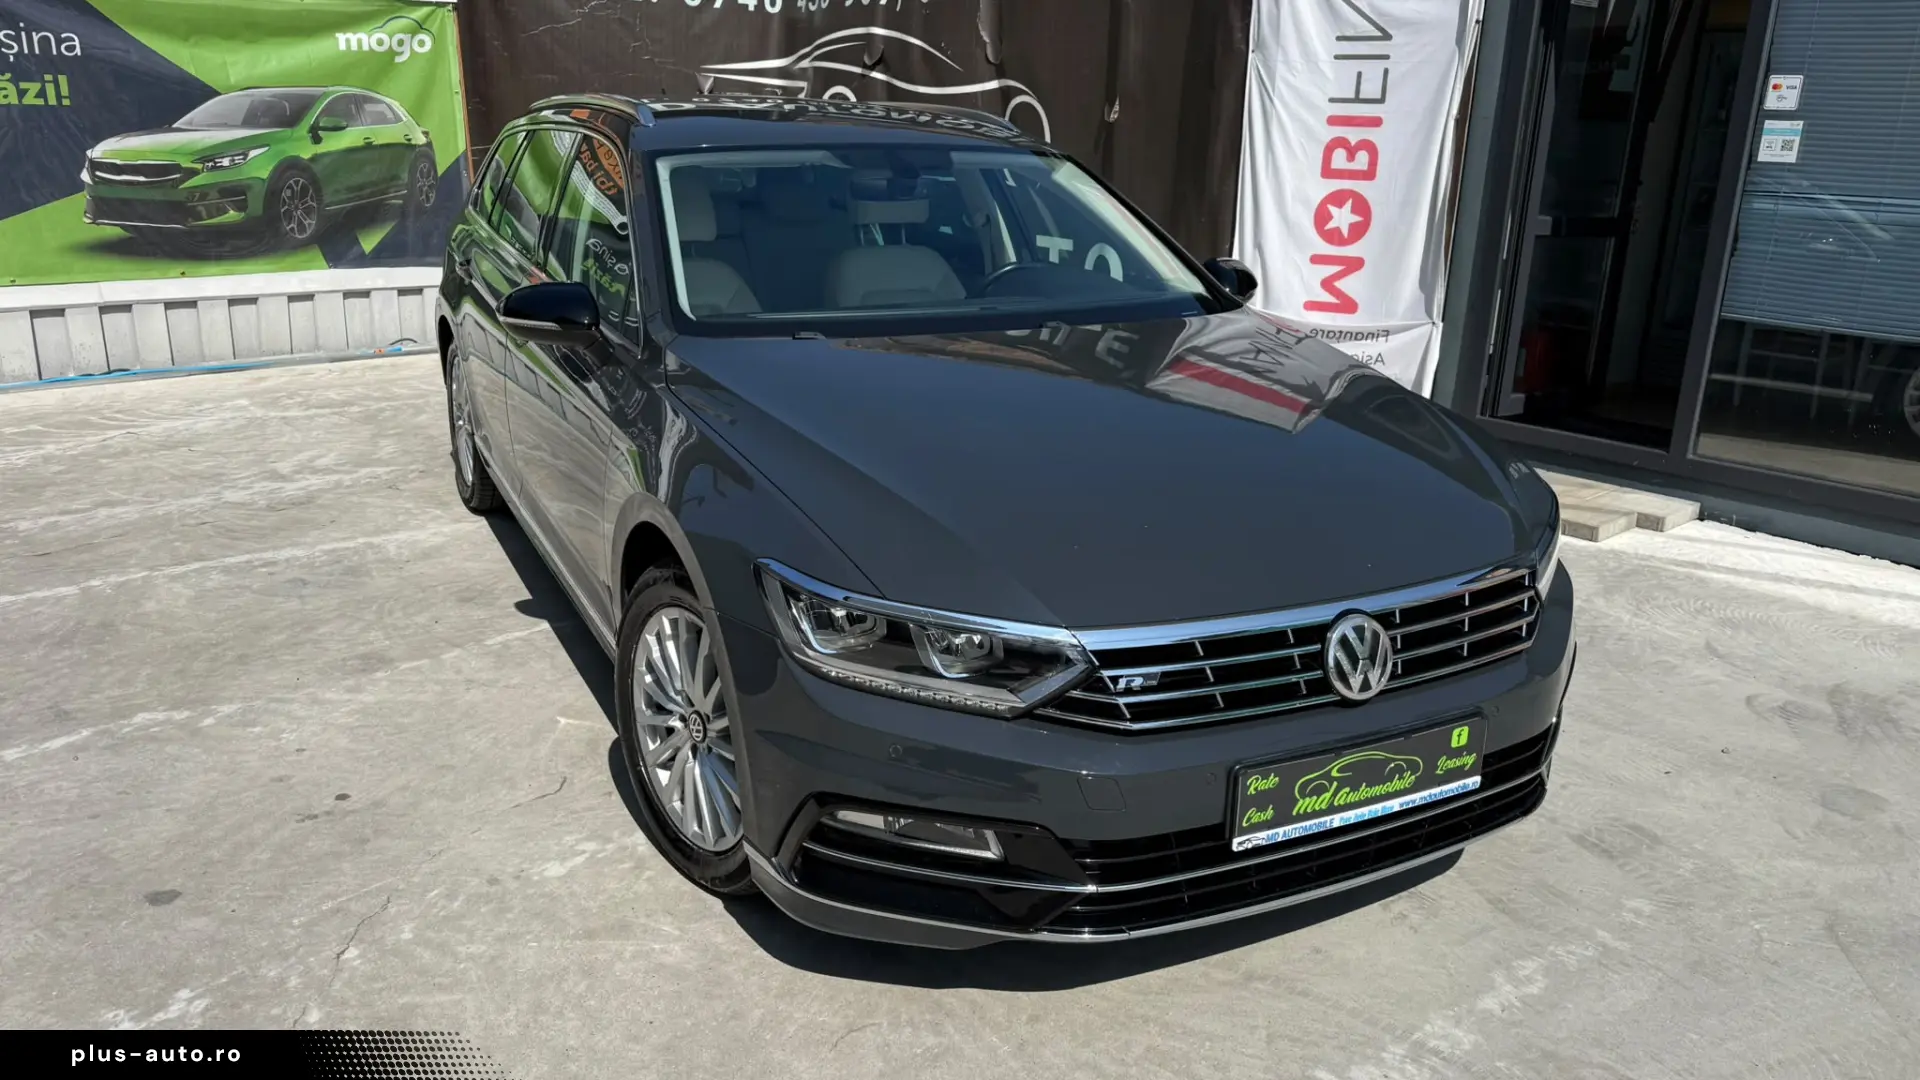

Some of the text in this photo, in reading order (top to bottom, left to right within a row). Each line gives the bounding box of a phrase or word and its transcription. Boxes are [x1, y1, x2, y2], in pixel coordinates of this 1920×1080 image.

[335, 32, 432, 63] mogo
[1435, 751, 1477, 774] Leasing
[1246, 772, 1279, 795] Rate
[1292, 781, 1338, 816] md
[1242, 804, 1275, 827] Cash
[1280, 818, 1335, 839] AUTOMOBILE
